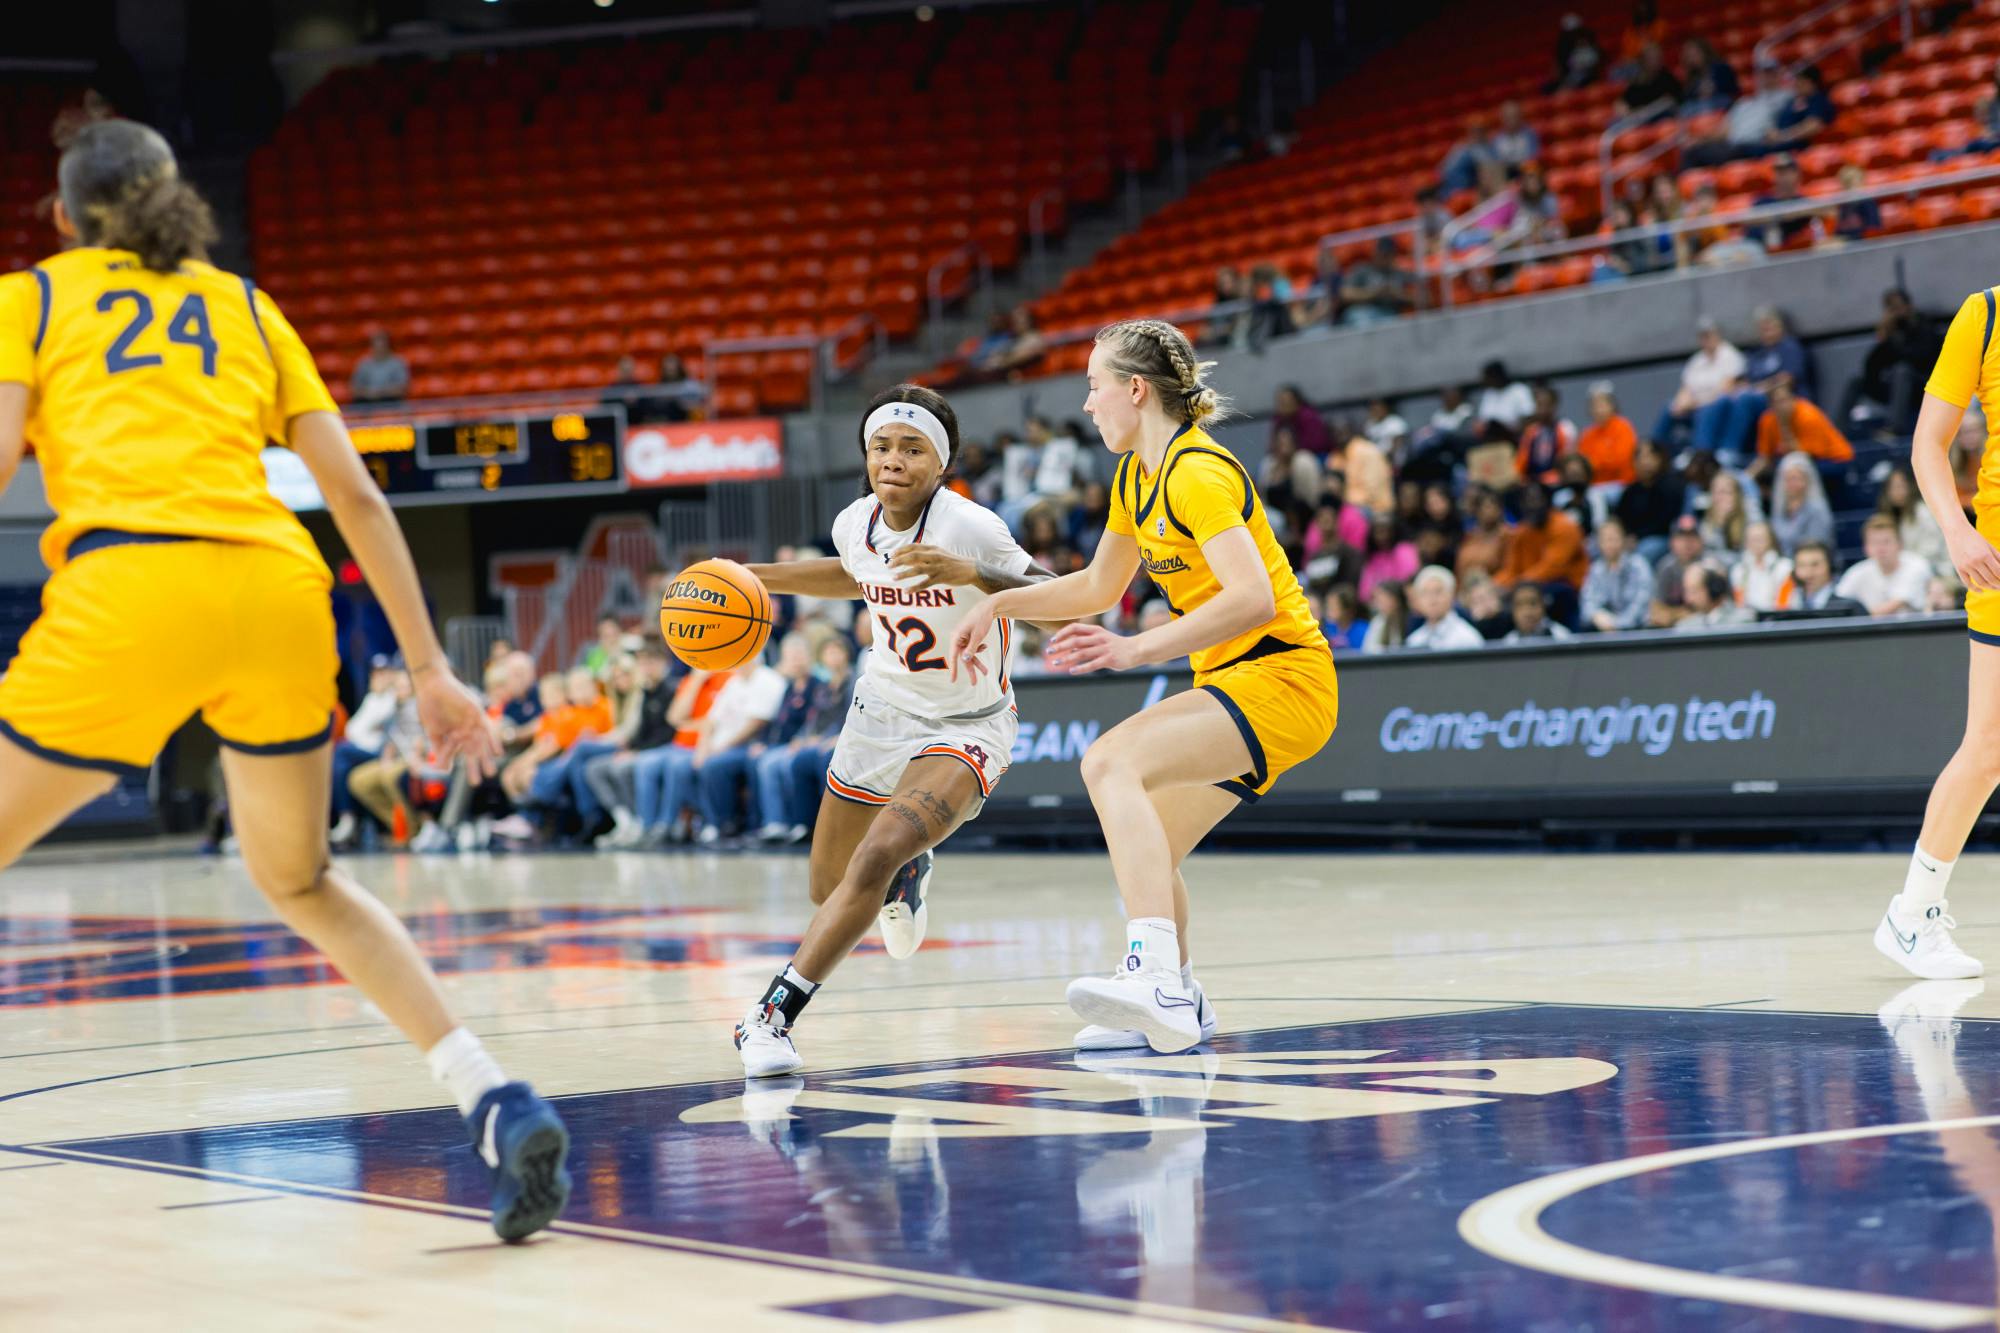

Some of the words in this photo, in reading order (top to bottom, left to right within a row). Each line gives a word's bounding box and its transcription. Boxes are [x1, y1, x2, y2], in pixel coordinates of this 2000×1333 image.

[96, 289, 218, 377] 24
[665, 580, 727, 608] Wilson
[877, 614, 949, 673] 12
[1380, 697, 1678, 757] Game-changing
[1683, 690, 1777, 742] tech
